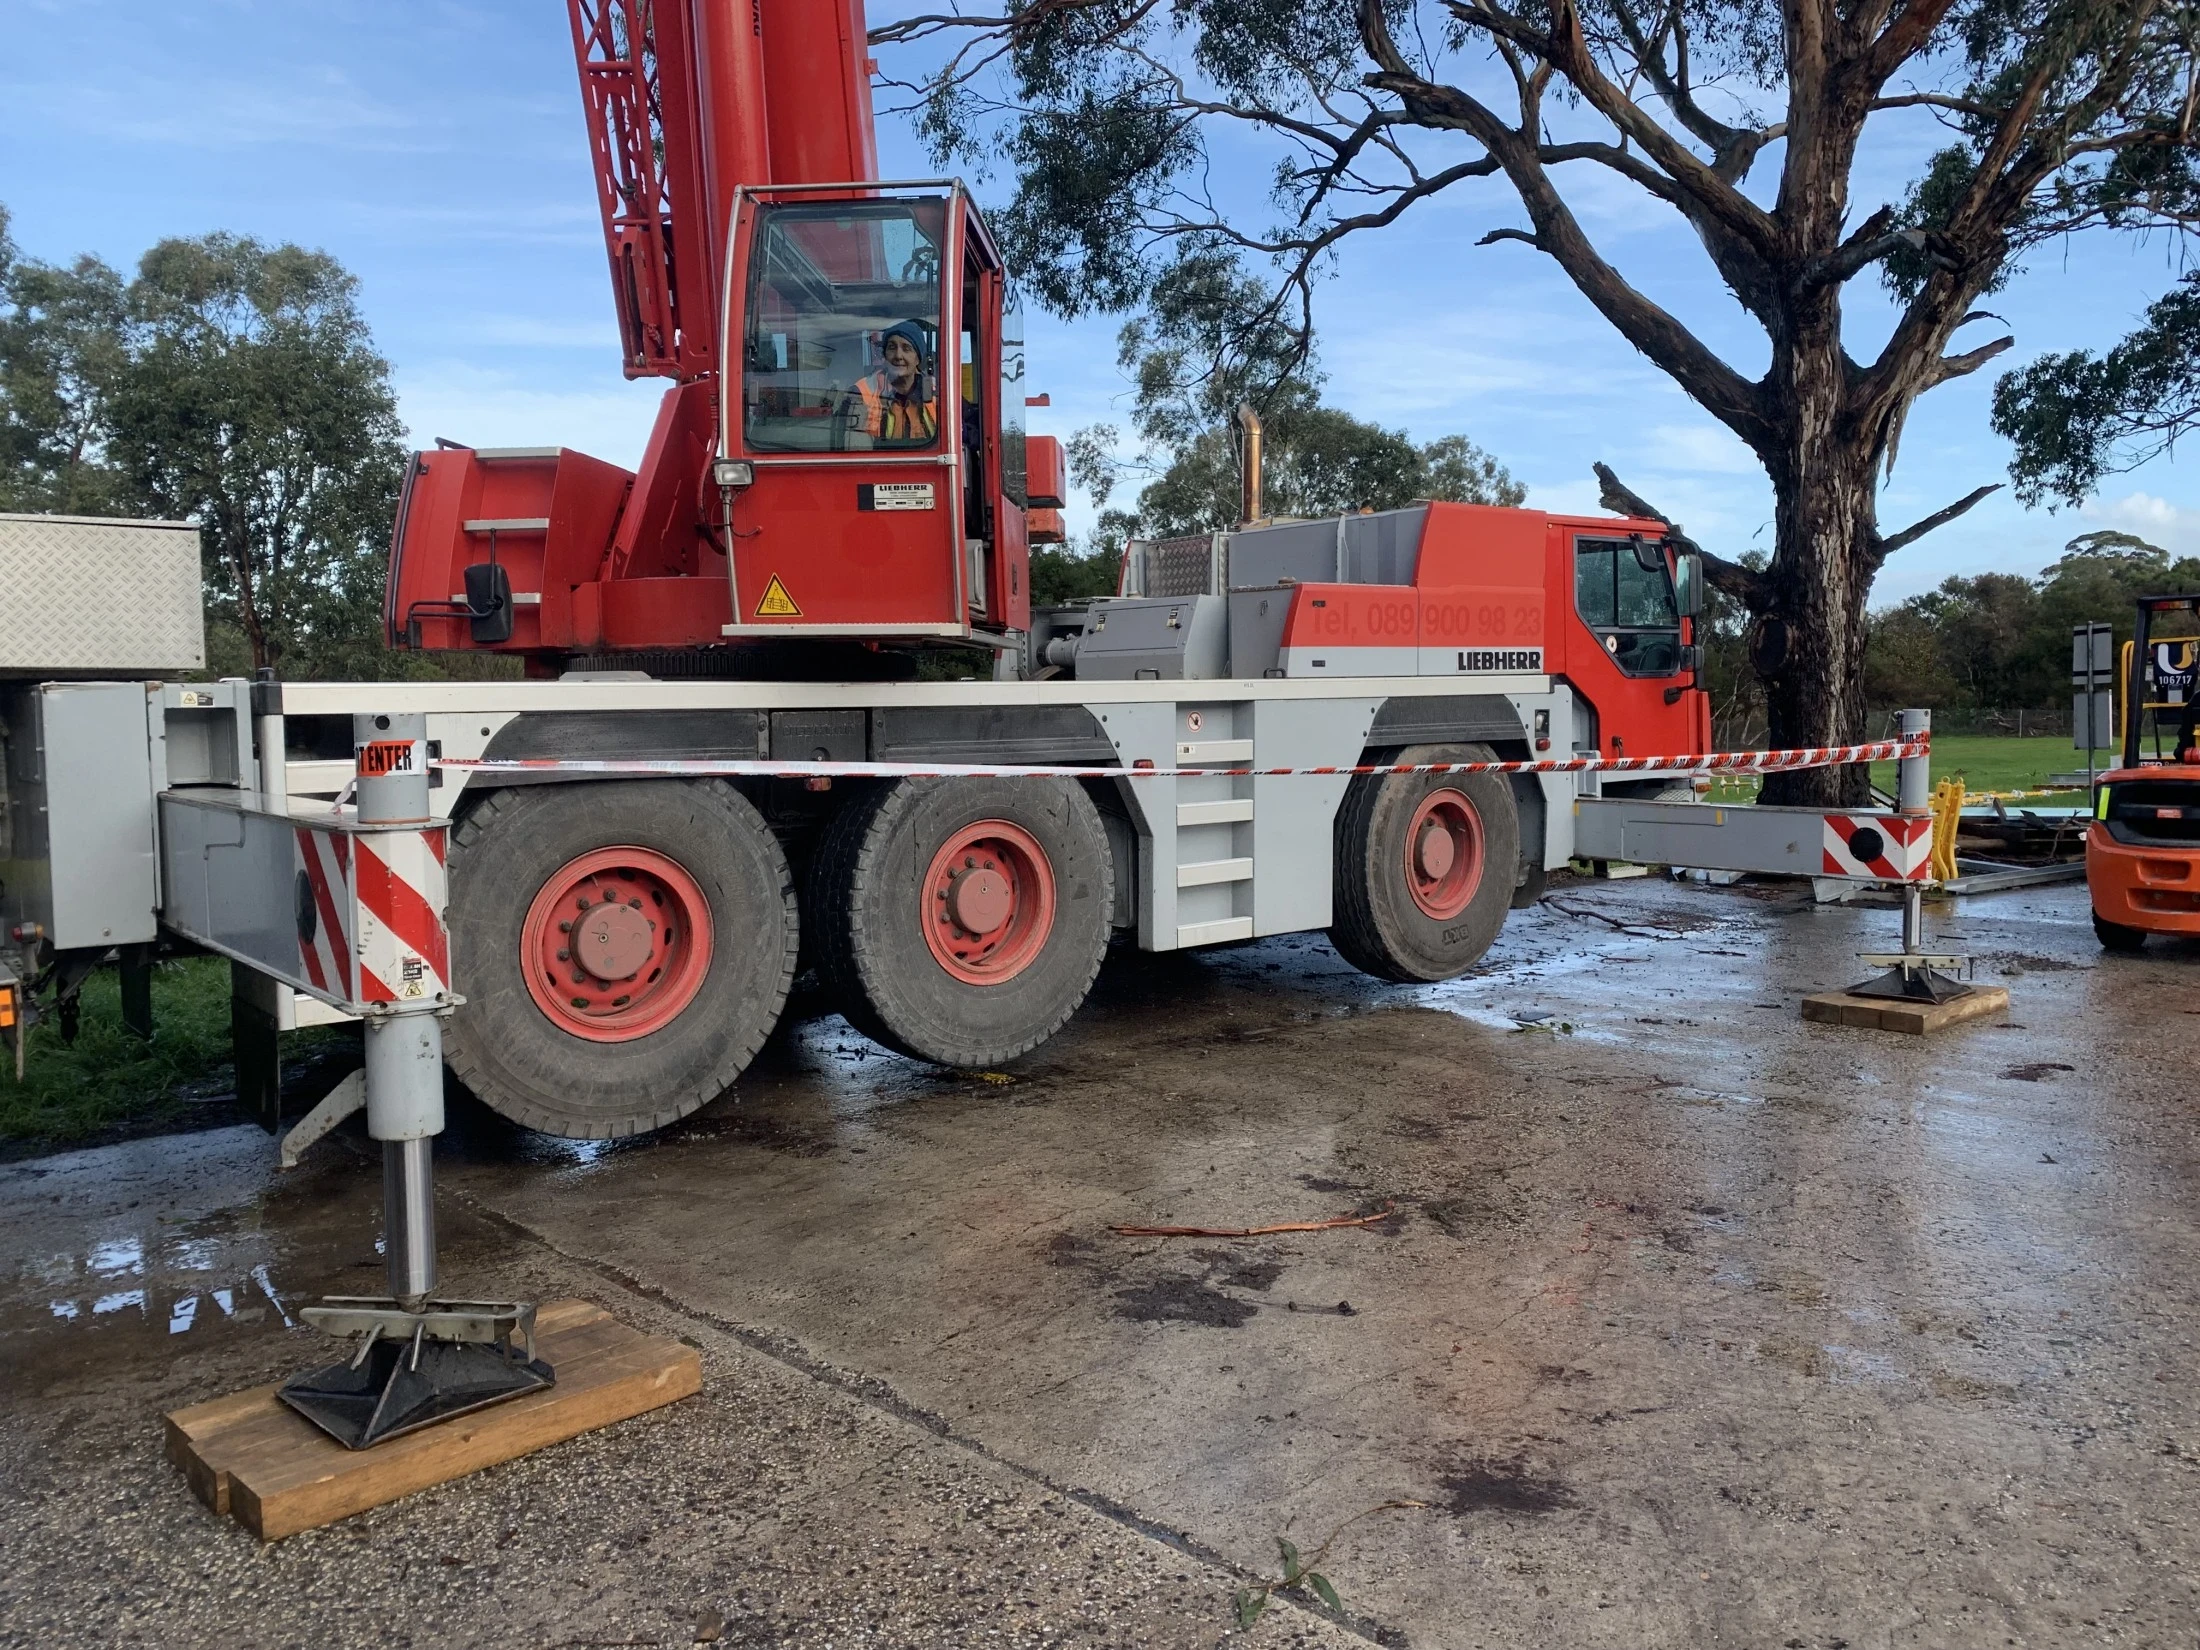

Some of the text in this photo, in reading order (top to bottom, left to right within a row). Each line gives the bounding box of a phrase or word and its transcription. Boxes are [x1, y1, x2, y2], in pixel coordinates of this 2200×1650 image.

[1478, 605, 1507, 636] 98
[1513, 606, 1542, 637] 23
[1457, 651, 1541, 671] LIEBHERR
[2158, 675, 2193, 685] 106717
[366, 744, 412, 772] ENTER
